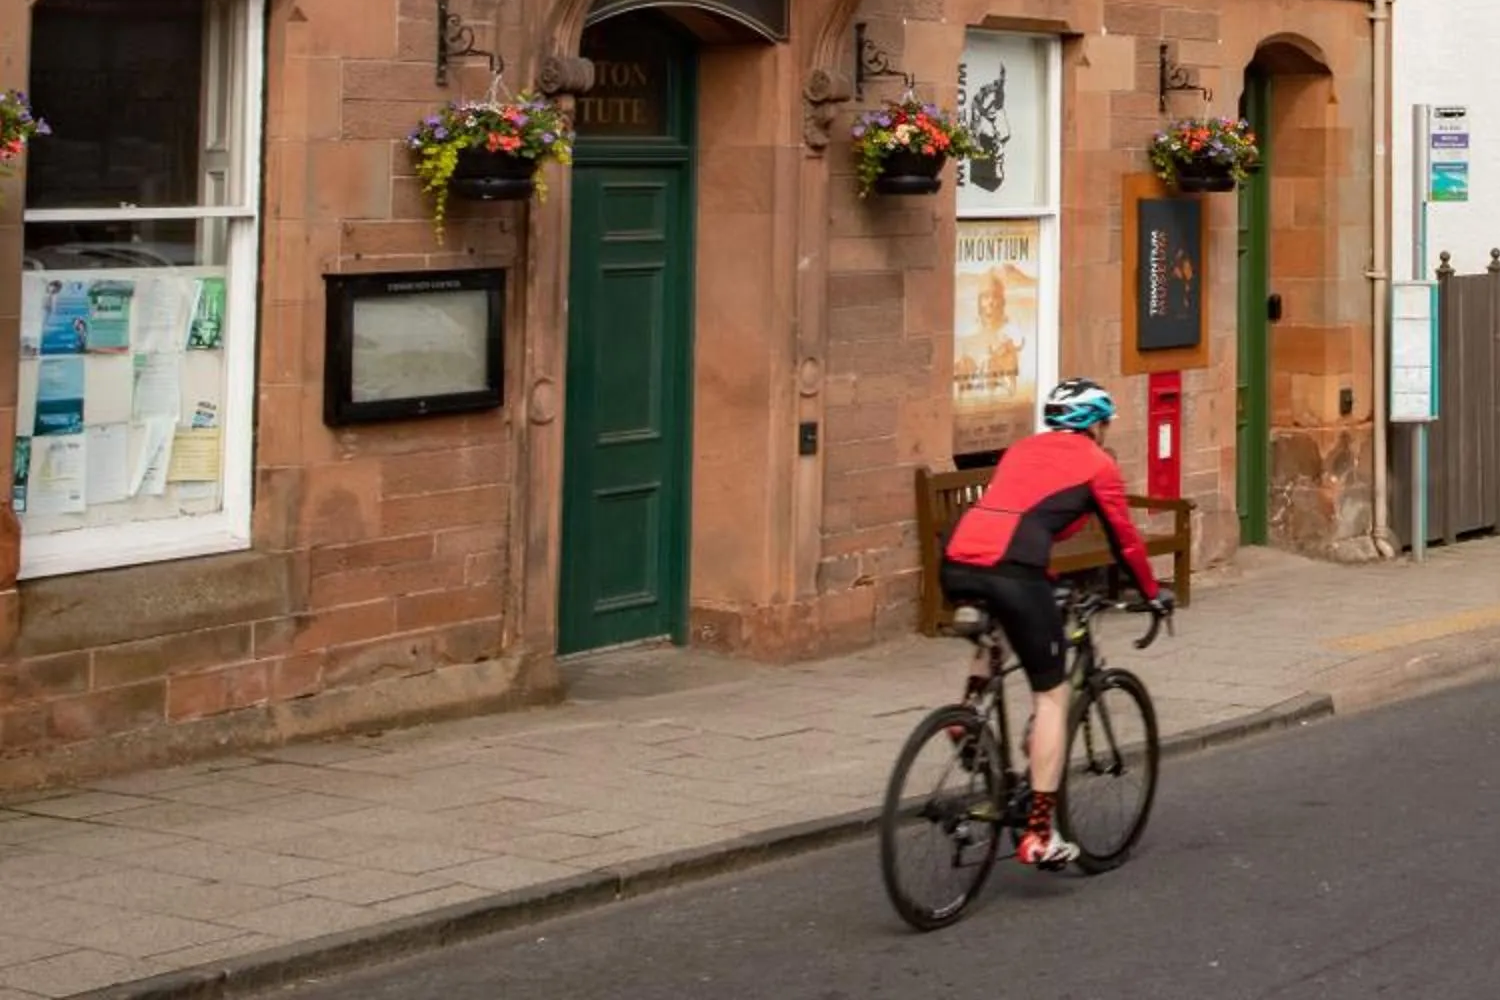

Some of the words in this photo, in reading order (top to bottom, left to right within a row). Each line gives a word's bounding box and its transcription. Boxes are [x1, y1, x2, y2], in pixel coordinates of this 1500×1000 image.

[594, 60, 648, 86] TON
[577, 96, 648, 125] TUTE
[958, 236, 1030, 263] IMONTIUM
[1149, 229, 1159, 317] TRIMONTIUM
